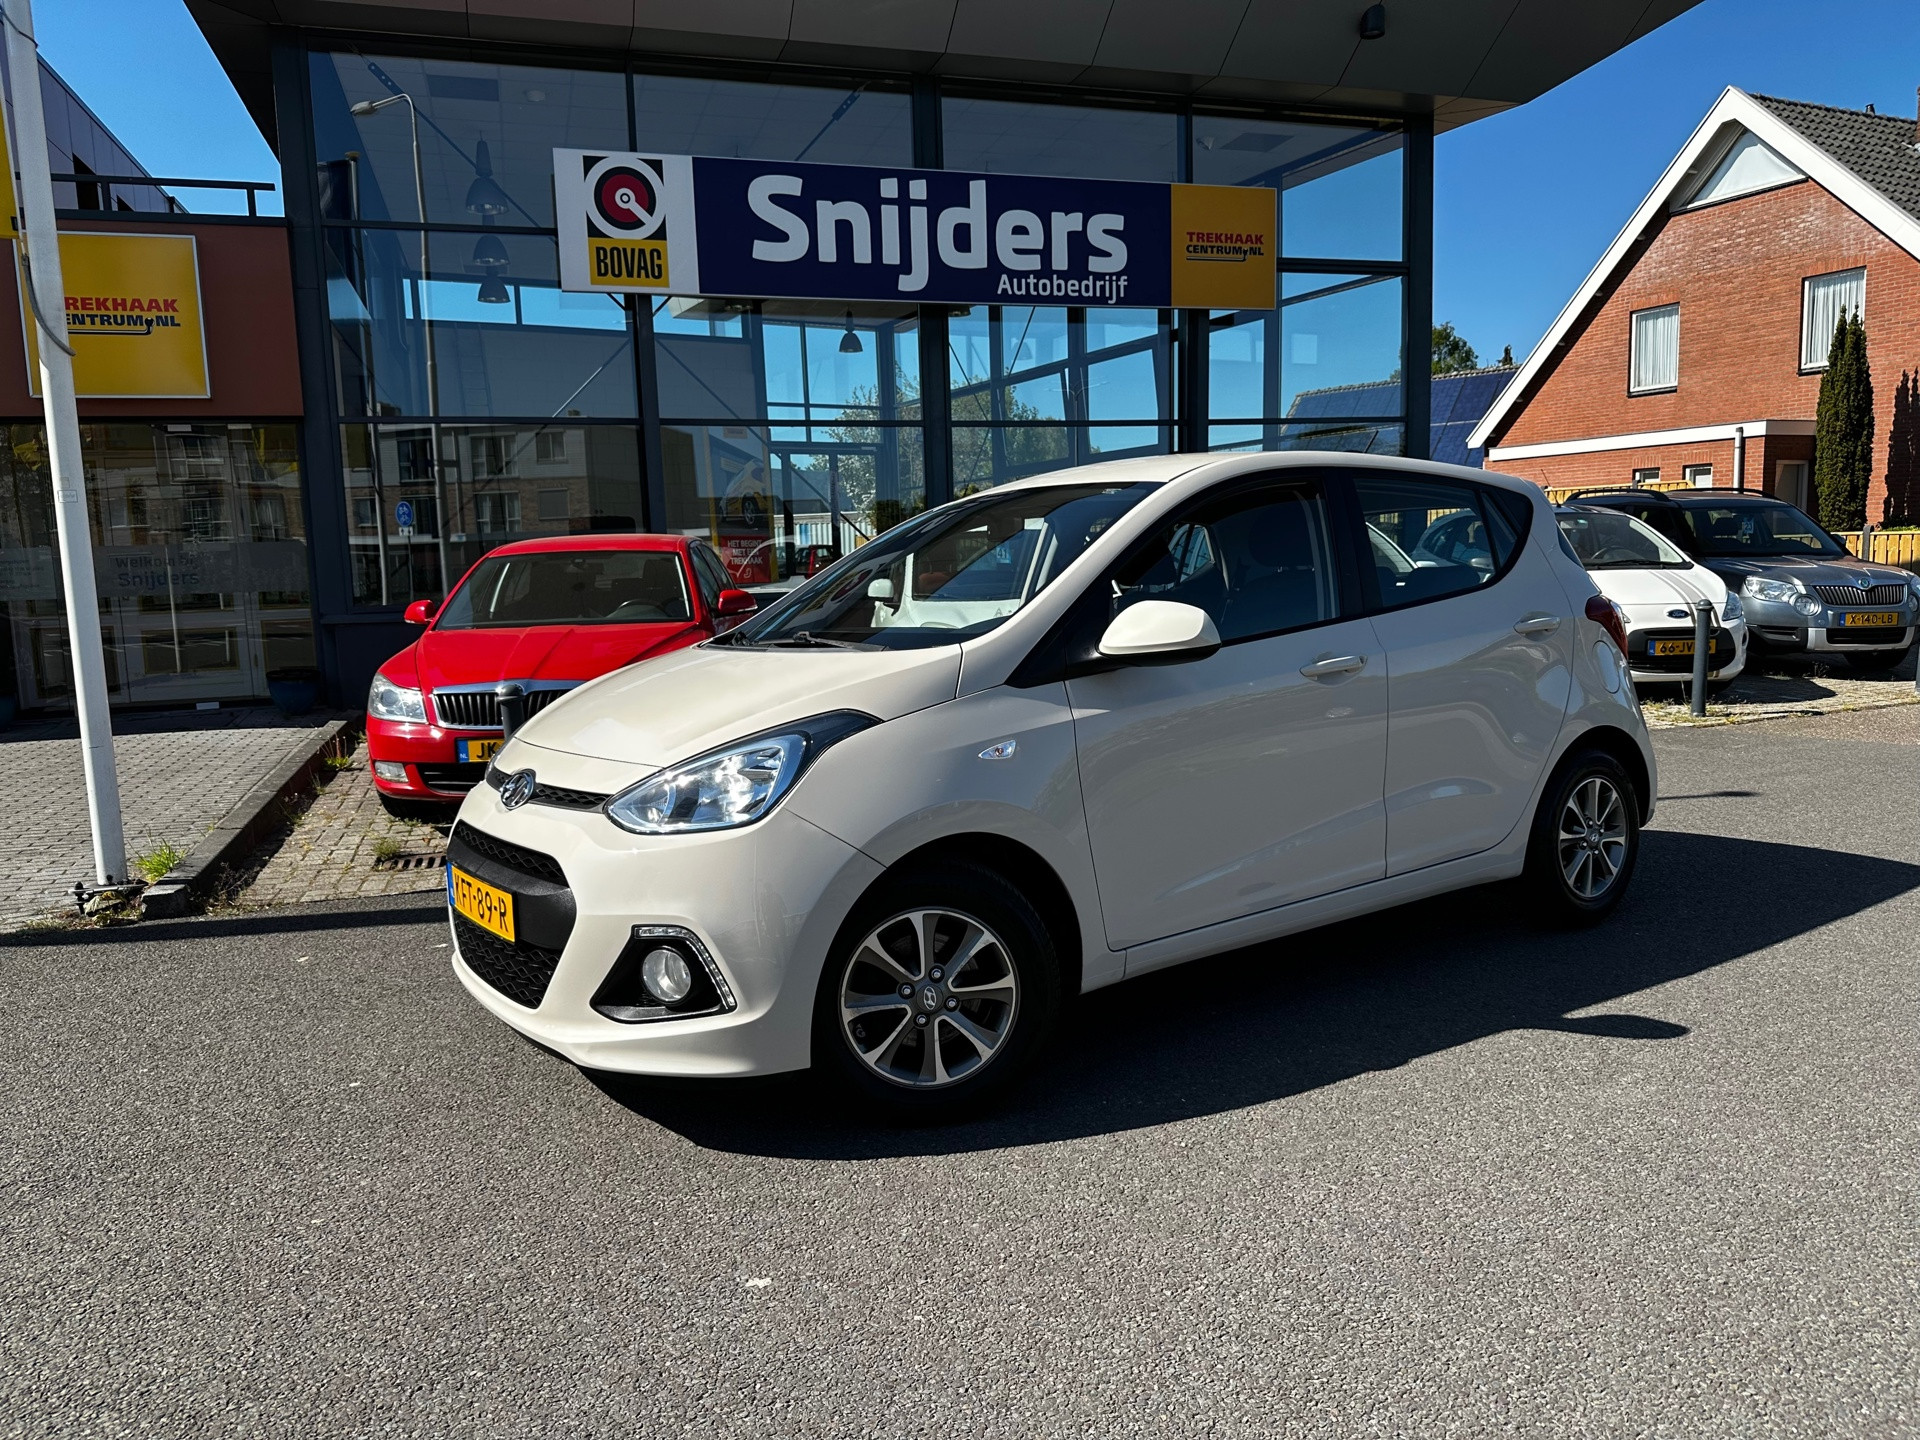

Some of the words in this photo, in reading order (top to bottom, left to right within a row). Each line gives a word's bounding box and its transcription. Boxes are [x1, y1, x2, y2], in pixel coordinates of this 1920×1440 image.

[747, 174, 1128, 292] Snijders
[1186, 231, 1264, 245] TREKHAAK
[595, 246, 663, 280] BOVAG
[997, 274, 1128, 304] Autobedrijf
[64, 296, 179, 313] REKHAAK
[727, 540, 739, 548] HET
[732, 548, 746, 556] MET
[118, 570, 200, 591] Snijders
[1850, 614, 1893, 625] X-140-LB
[1660, 641, 1711, 654] 66-JV
